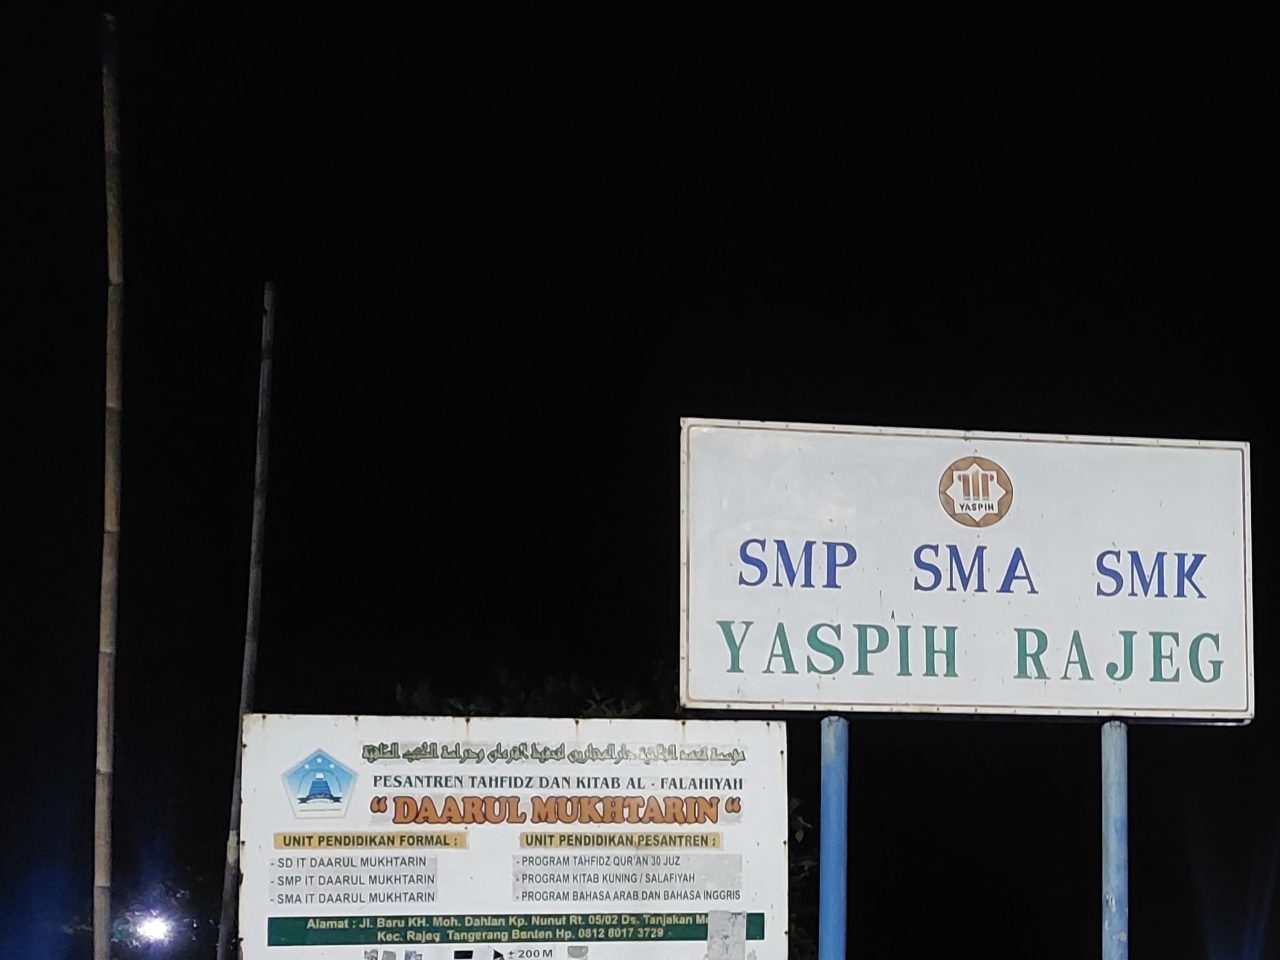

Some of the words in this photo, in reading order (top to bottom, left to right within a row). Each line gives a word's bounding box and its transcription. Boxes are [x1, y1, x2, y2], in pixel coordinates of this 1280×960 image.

[959, 503, 994, 511] YASPIH
[738, 538, 857, 589] SMP
[913, 543, 1039, 595] SMA
[1096, 549, 1207, 599] SMK
[716, 619, 959, 678] YASPIH
[1013, 626, 1224, 683] RAJEG
[373, 775, 463, 789] PESANTREN
[468, 775, 534, 789] TAHFIDZ
[538, 775, 571, 789] DAN
[576, 776, 621, 790] KITAB
[626, 776, 646, 790] AL
[660, 776, 744, 791] FALAHIYAH
[392, 795, 527, 825] DAARUL
[530, 795, 721, 825] MUKHTARIN
[282, 835, 314, 847] UNIT
[317, 835, 395, 847] PENDIDIKAN
[399, 835, 450, 847] FORMAL
[525, 835, 555, 846] UNIT
[558, 834, 634, 847] PENDIDIKAN
[637, 835, 710, 847] PESANTREN
[277, 857, 293, 868] SD
[296, 857, 306, 868] IT
[309, 857, 357, 868] DAARUL
[360, 856, 427, 868] MUKHTARIN
[521, 856, 570, 867] PROGRAM
[573, 855, 611, 866] TAHFIDZ
[613, 855, 649, 866] QUR'AN
[651, 855, 661, 866] 30
[663, 855, 681, 866] JUZ
[277, 876, 302, 887] SMP
[305, 876, 315, 886] IT
[318, 875, 365, 886] DAARUL
[368, 874, 436, 886] MUKHTARIN
[521, 873, 570, 884] PROGRAM
[572, 873, 600, 884] KITAB
[602, 873, 638, 884] KUNING
[644, 872, 696, 884] SALAFIYAH
[277, 894, 302, 905] SMA
[305, 893, 315, 904] IT
[318, 893, 366, 904] DAARUL
[368, 892, 436, 904] MUKHTARIN
[521, 891, 570, 902] PROGRAM
[572, 890, 613, 902] BAHASA
[612, 890, 640, 901] ARAB
[641, 890, 661, 901] DAN
[663, 890, 701, 901] BAHASA
[703, 889, 741, 901] INGGRIS
[307, 918, 350, 929] Alamat
[359, 918, 373, 929] Jl.
[376, 918, 405, 928] Baru
[408, 917, 430, 928] KH.
[432, 917, 462, 928] Moh.
[464, 917, 506, 928] Dahlan
[508, 916, 530, 928] Kp.
[569, 915, 586, 926] Rt.
[588, 915, 619, 926] 05/02
[621, 915, 641, 926] Ds.
[643, 914, 693, 927] Tanjakan
[377, 931, 403, 942] Kec.
[447, 930, 509, 943] Tangerang
[511, 929, 552, 940] Banten
[556, 928, 576, 941] Hp.
[578, 928, 605, 939] 0812
[607, 928, 635, 939] 8017
[637, 928, 665, 939] 3729
[518, 949, 540, 959] 200
[542, 949, 554, 958] M
